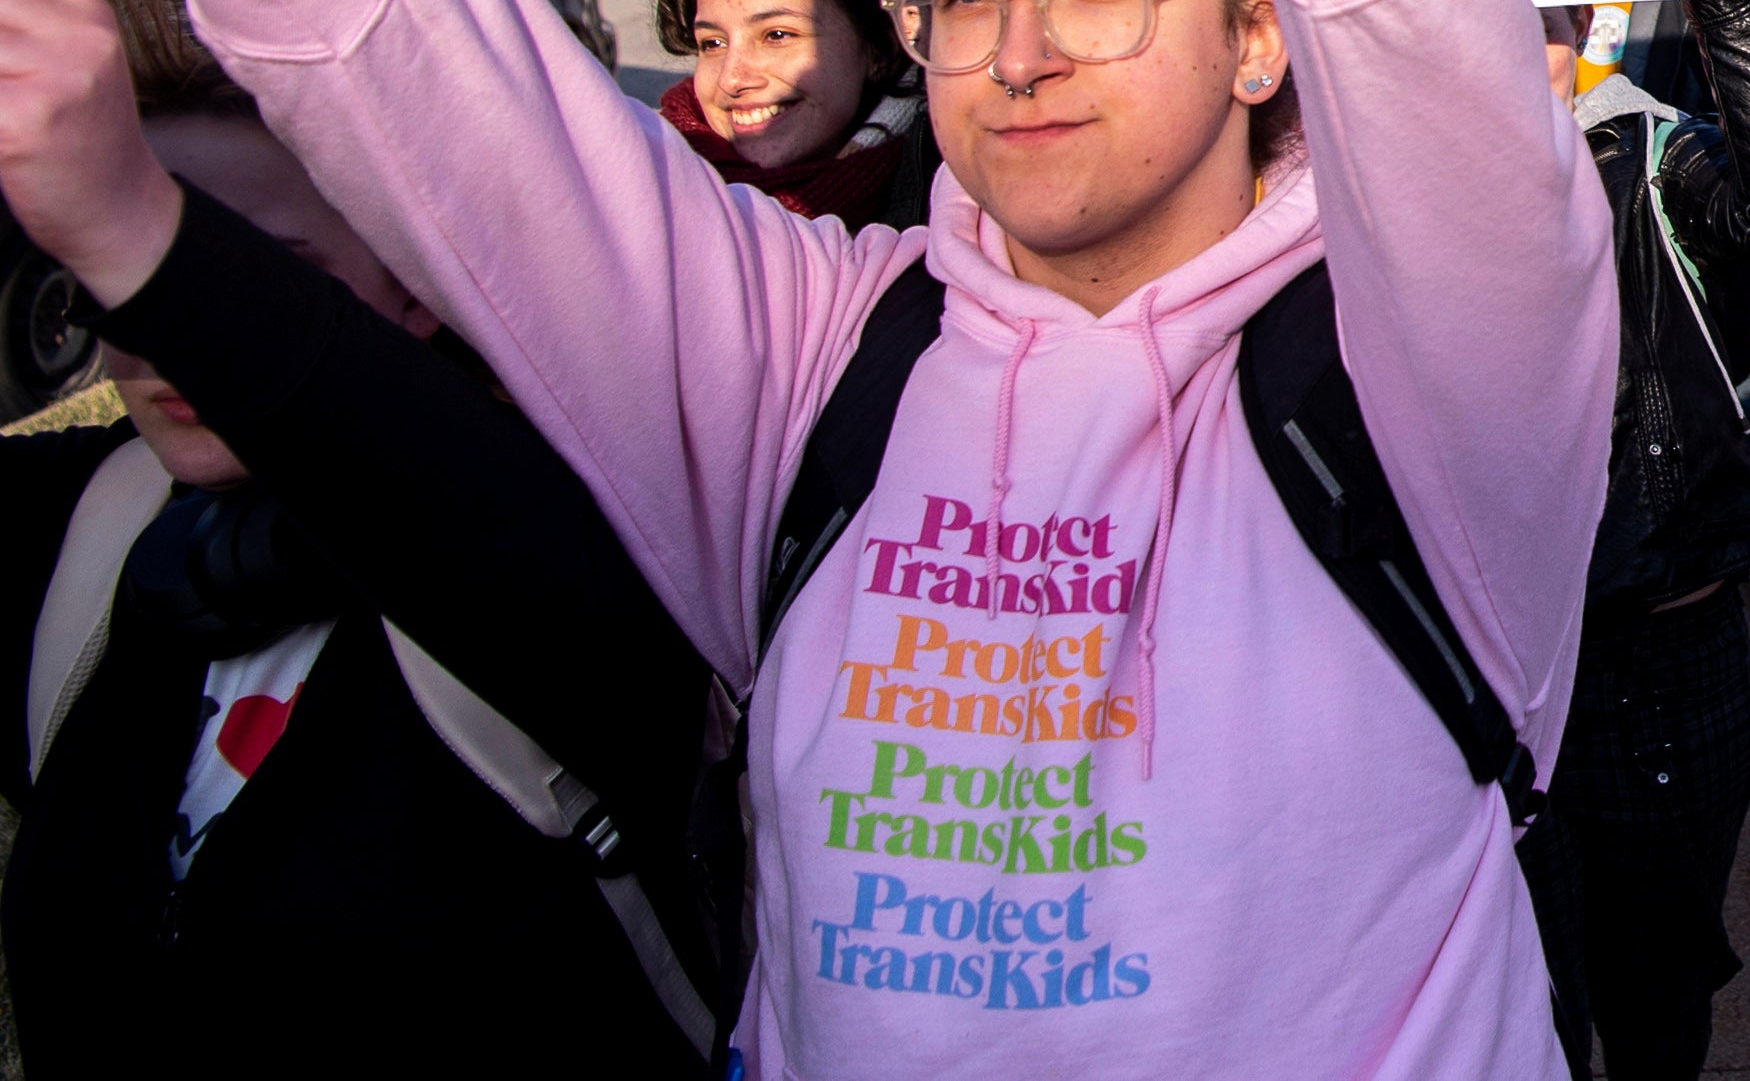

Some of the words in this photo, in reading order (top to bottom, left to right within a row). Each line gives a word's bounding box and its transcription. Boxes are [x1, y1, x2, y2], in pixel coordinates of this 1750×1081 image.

[892, 615, 1112, 685] Protect
[838, 660, 1138, 744] TransKids
[869, 740, 1096, 812] Protect
[819, 788, 1148, 875] TransKids
[852, 871, 1093, 946] Protect
[812, 918, 1151, 1011] TransKids
